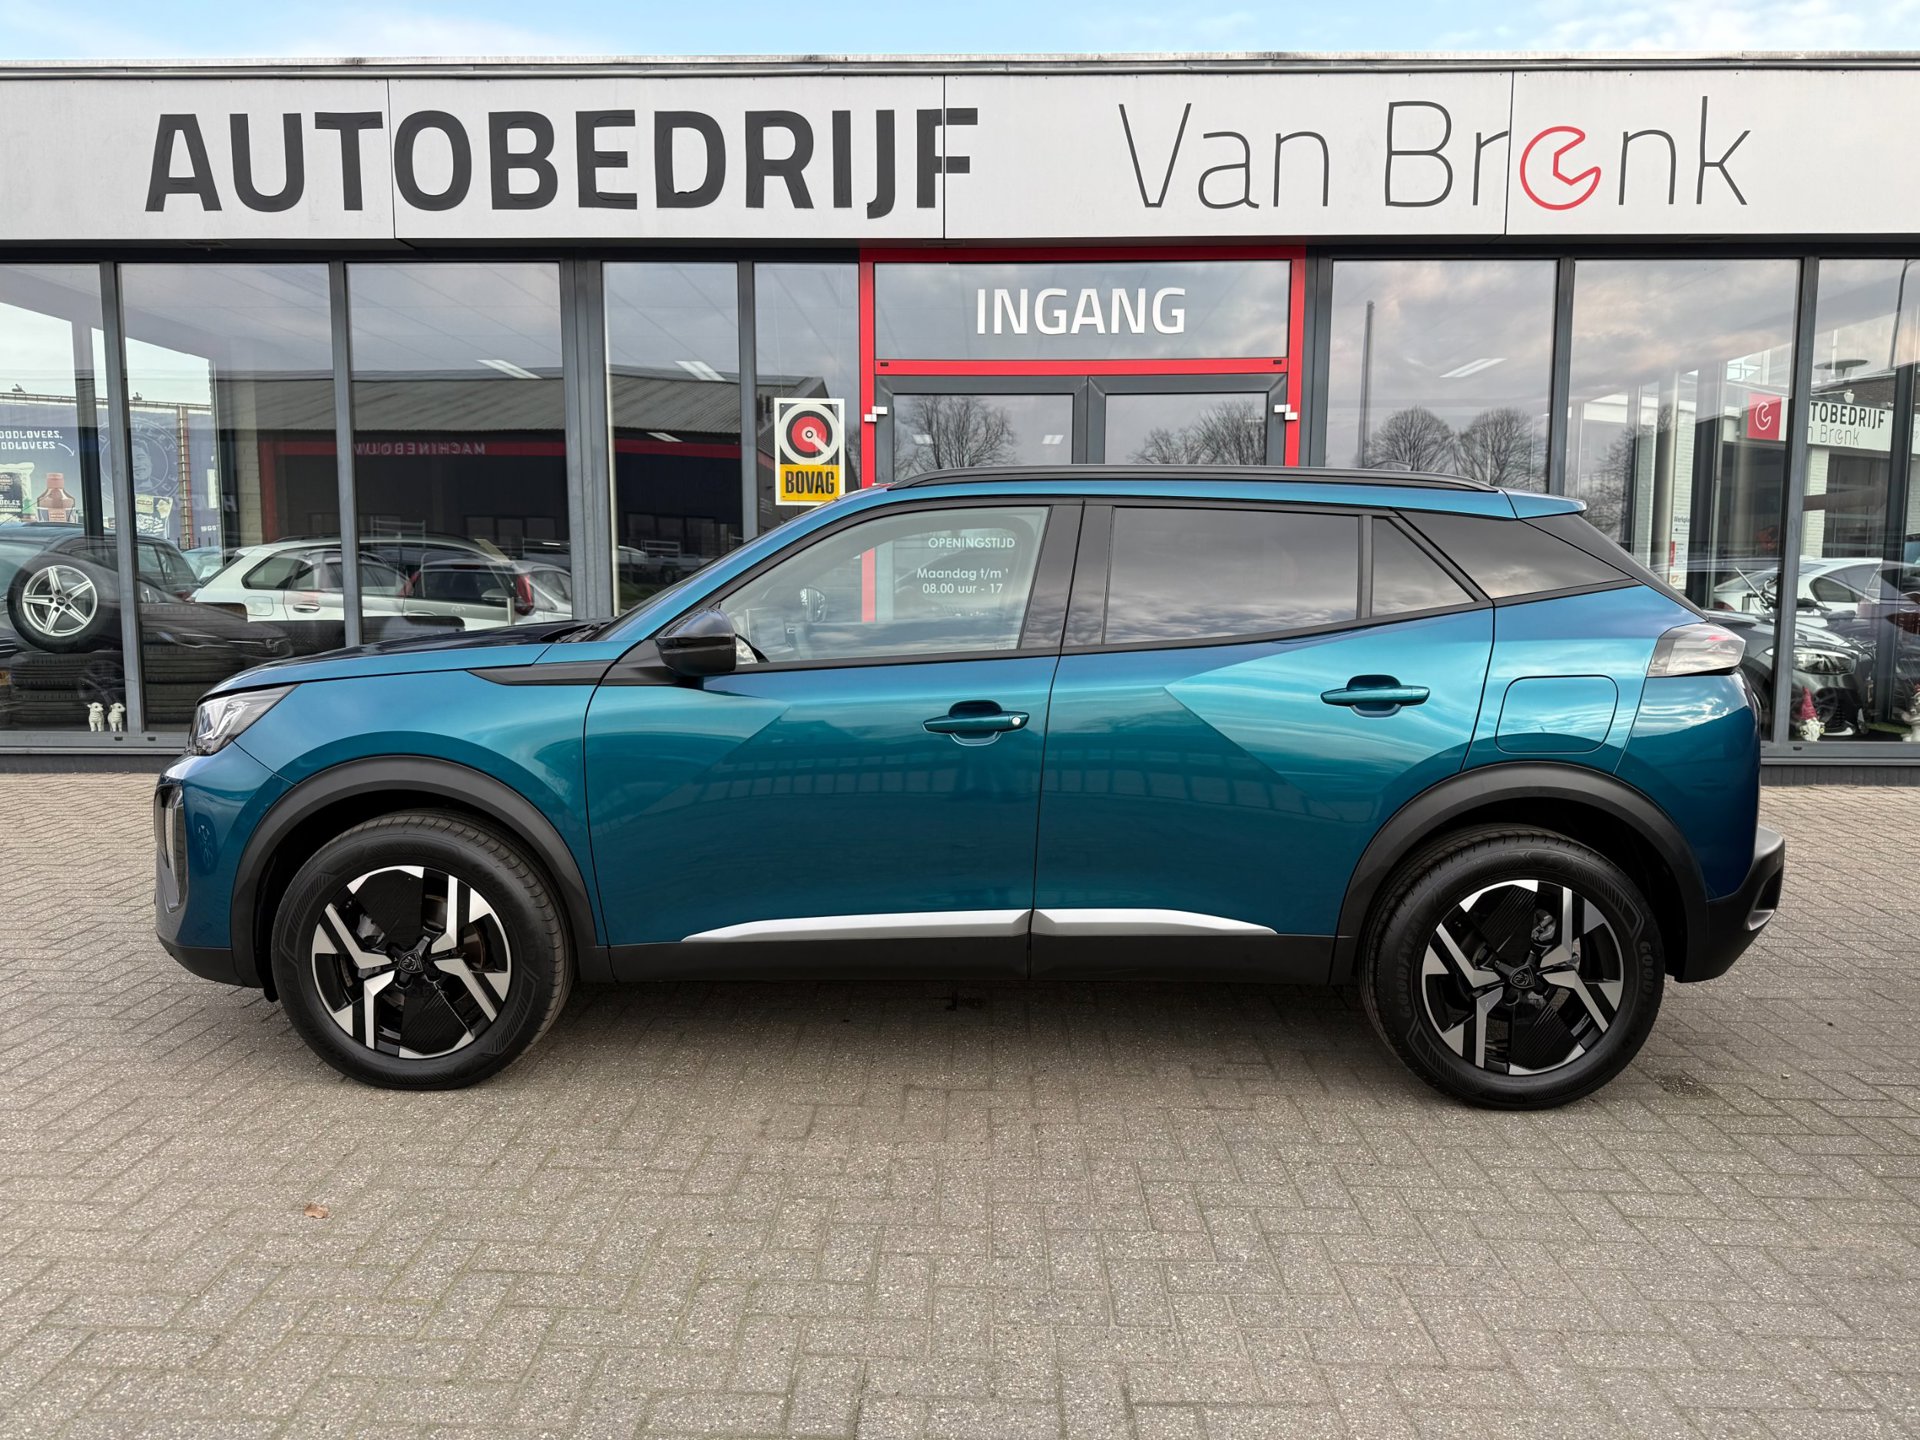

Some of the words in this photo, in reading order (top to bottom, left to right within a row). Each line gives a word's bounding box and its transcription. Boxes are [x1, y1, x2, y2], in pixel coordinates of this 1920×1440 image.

[145, 108, 979, 220] AUTOBEDRIJF
[1118, 102, 1329, 210] Van
[976, 287, 1186, 335] INGANG
[1810, 401, 1886, 430] TOBEDRIJF
[0, 430, 63, 440] OODLOVERS,
[1, 441, 56, 450] ODLOVERS
[785, 470, 835, 495] BOVAG
[927, 537, 1016, 549] OPENINGSTIJD
[916, 567, 977, 581] Maandag
[979, 568, 1002, 579] t/m
[922, 583, 954, 594] 08.00
[957, 585, 977, 594] uur
